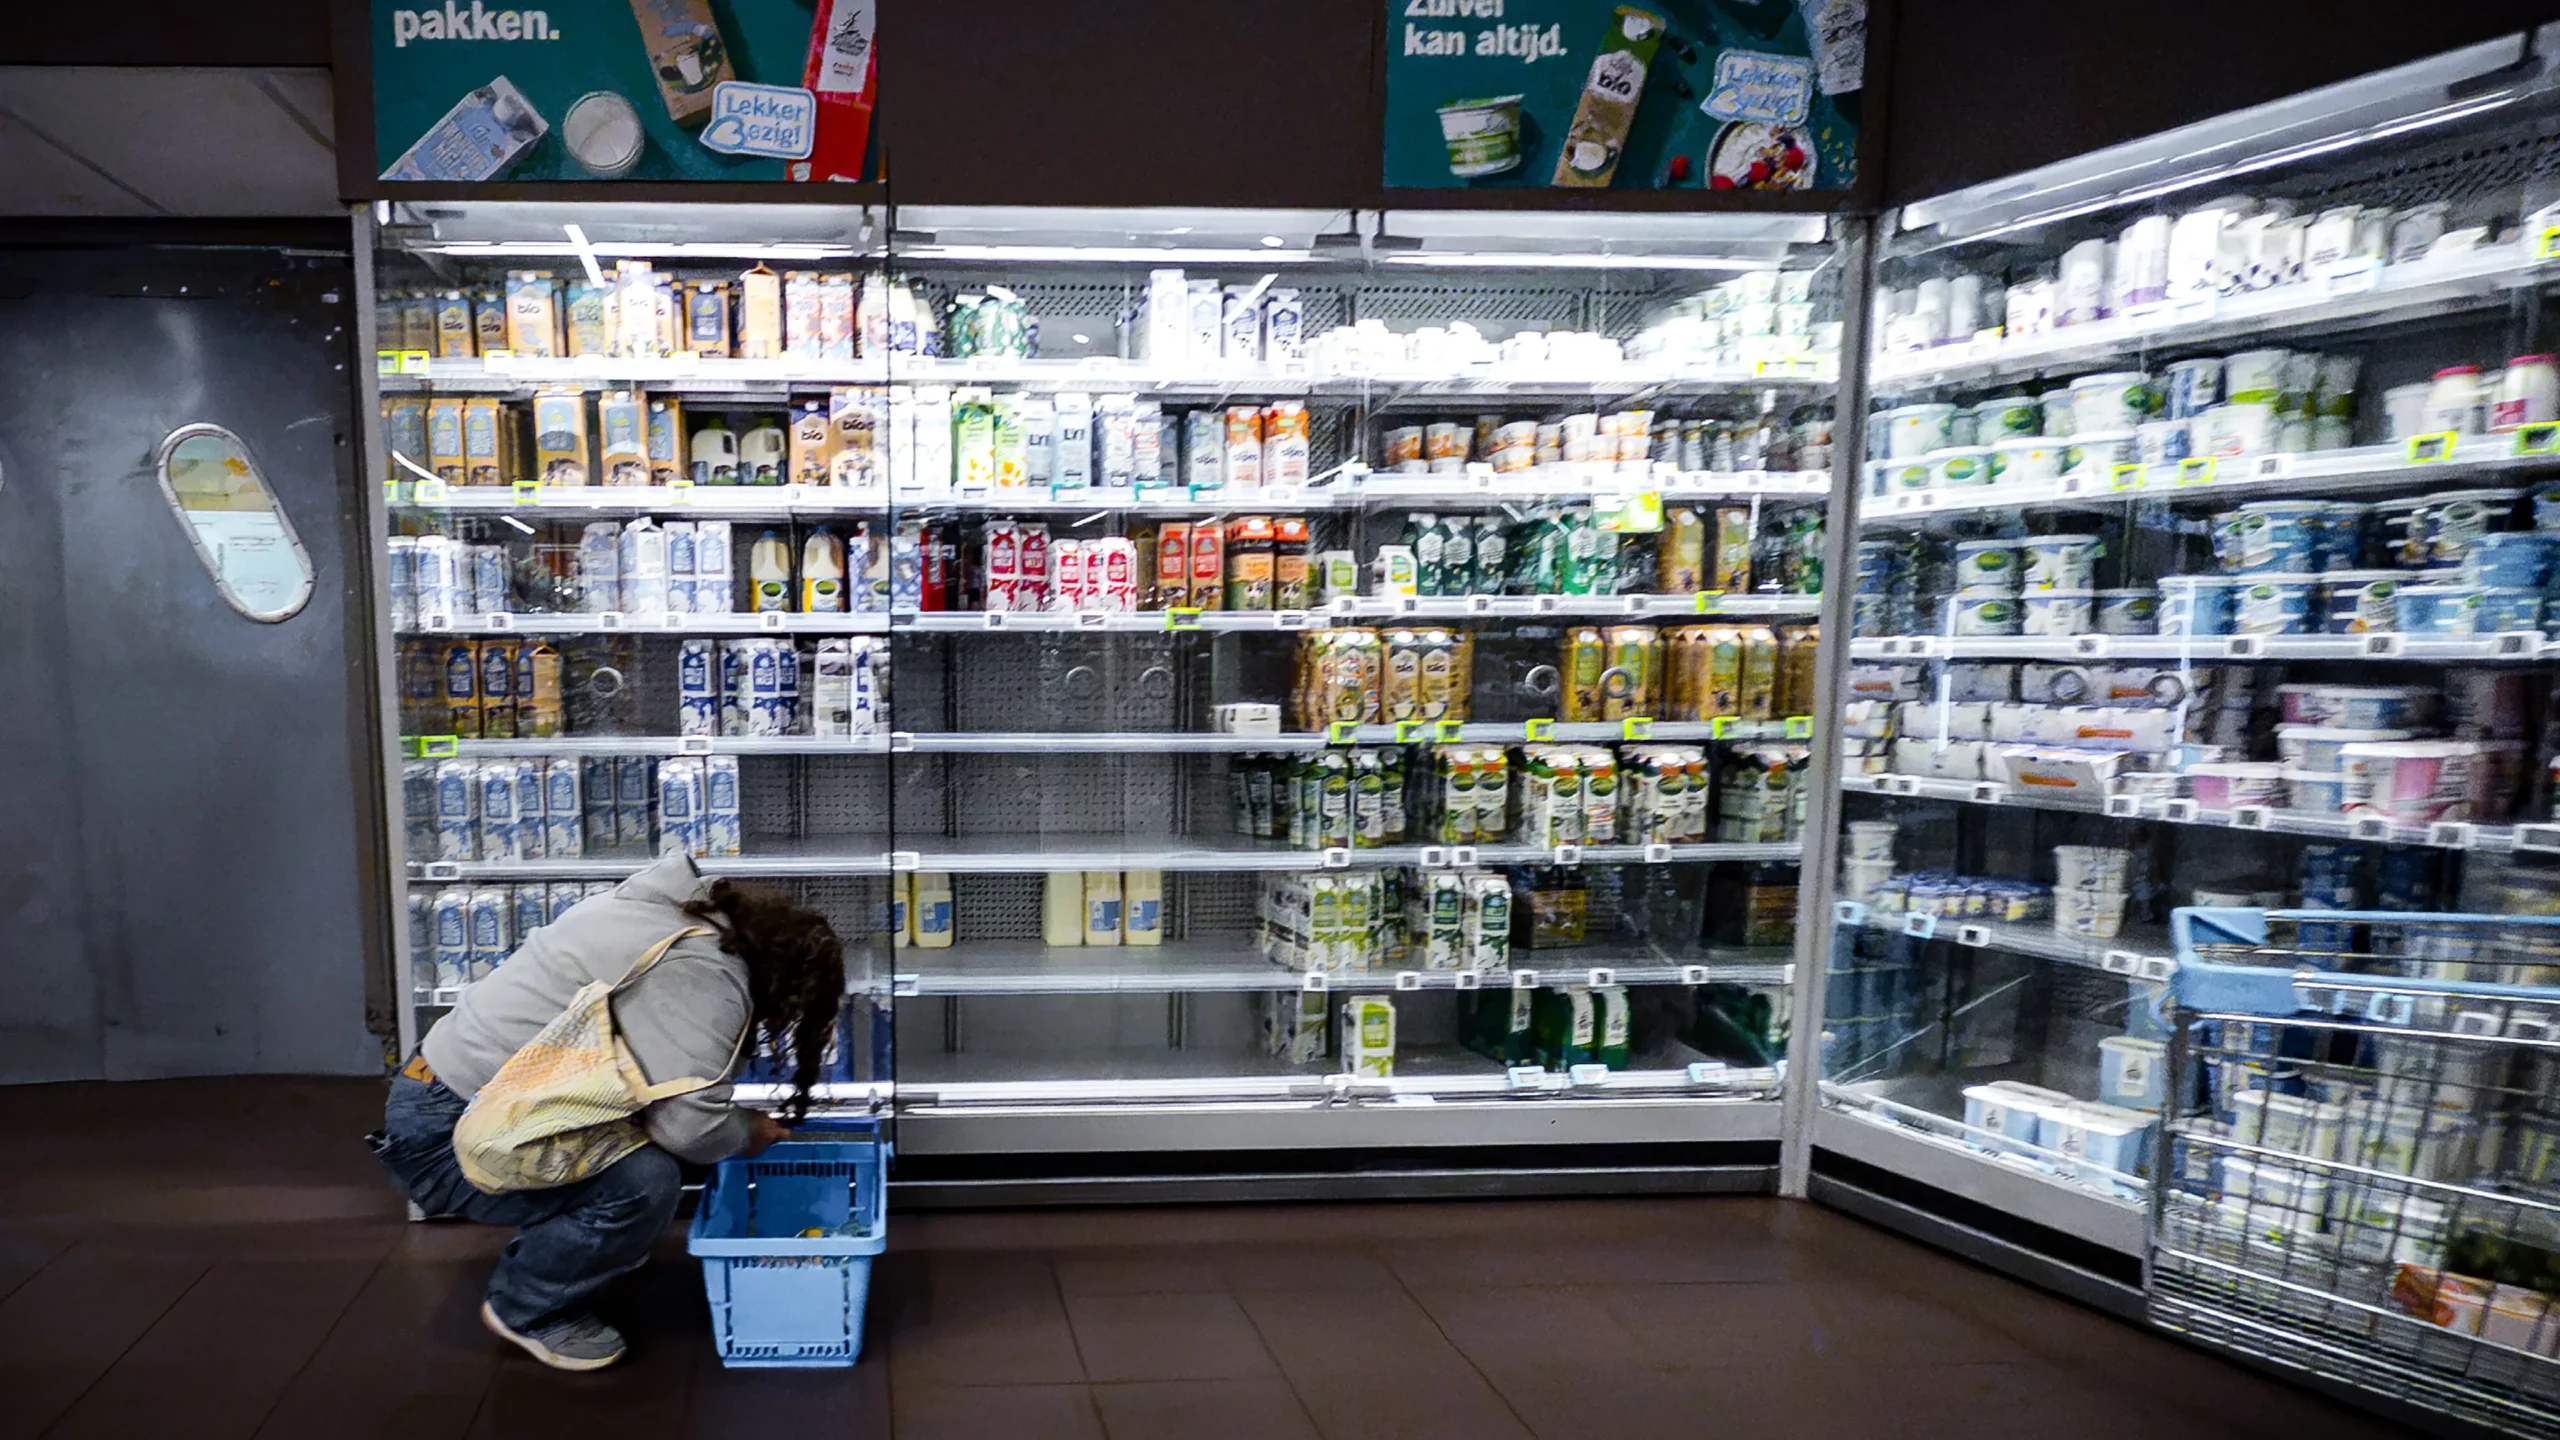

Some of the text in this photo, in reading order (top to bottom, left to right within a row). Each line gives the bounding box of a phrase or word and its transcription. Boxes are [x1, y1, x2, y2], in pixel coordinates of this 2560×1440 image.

[394, 0, 560, 47] pakken.
[1404, 22, 1568, 64] kan altijd.
[726, 94, 806, 121] Lekker
[801, 428, 824, 441] bio
